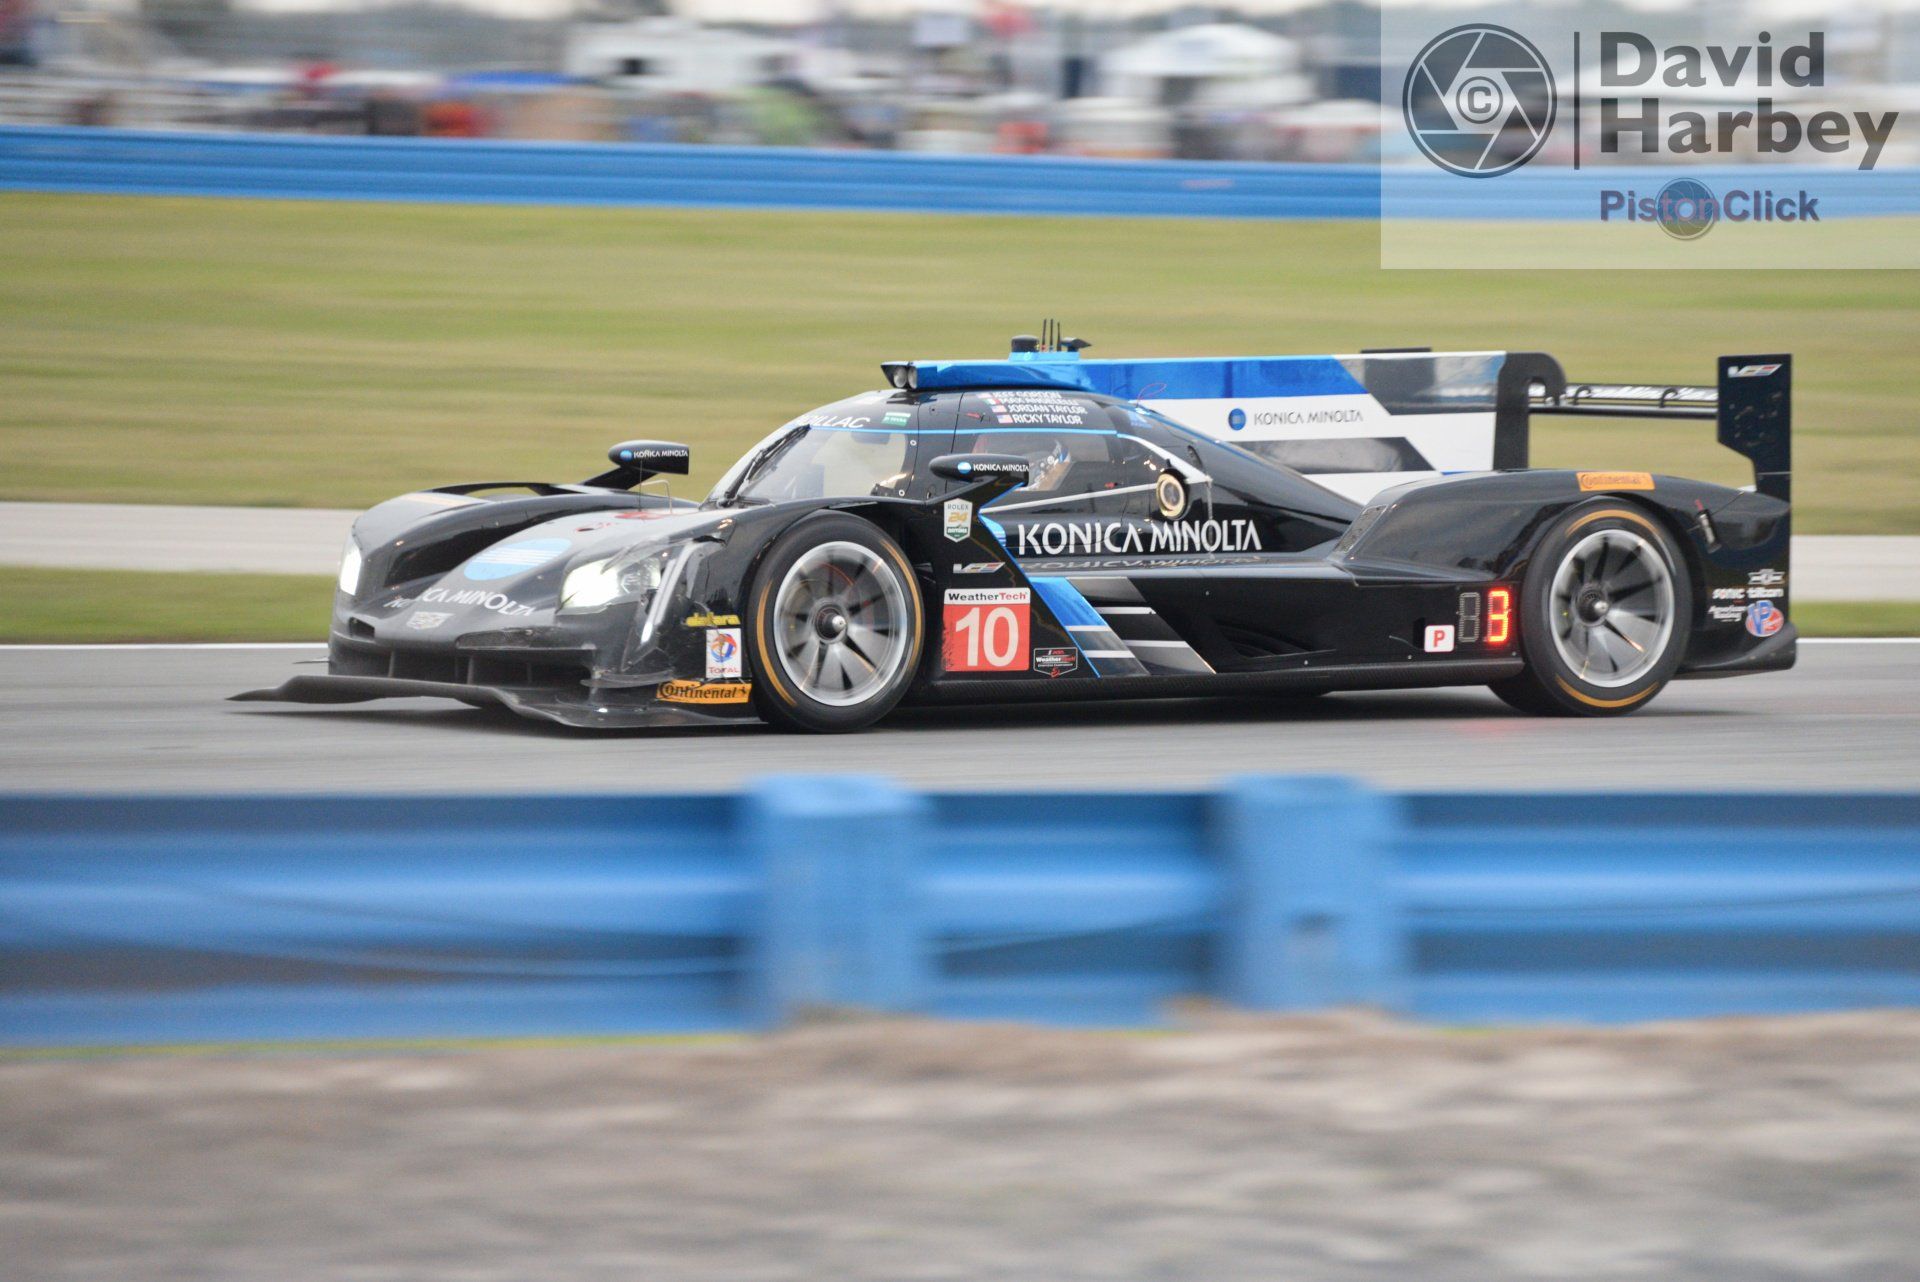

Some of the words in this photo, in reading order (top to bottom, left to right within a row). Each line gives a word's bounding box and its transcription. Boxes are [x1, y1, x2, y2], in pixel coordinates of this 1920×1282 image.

[1008, 404, 1049, 413] JORDAN
[1048, 405, 1088, 414] TAYLOR
[1254, 413, 1304, 426] KONICA
[1307, 409, 1364, 424] MINOLTA
[1012, 414, 1044, 423] RICKY
[1044, 414, 1083, 424] TAYLOR
[633, 449, 660, 459] KONICA
[661, 449, 689, 457] MINOLTA
[973, 463, 1001, 472] KONICA
[1001, 464, 1030, 472] MINOLTA
[1018, 522, 1144, 555] KONICA
[1150, 519, 1262, 552] MINOLTA
[447, 589, 537, 617] MINOLTA
[948, 592, 1027, 601] WeatherTech
[1487, 589, 1509, 642] 3
[955, 606, 1019, 667] 10
[1432, 630, 1446, 647] P
[708, 666, 740, 675] TOTAL
[660, 681, 738, 699] Continental
